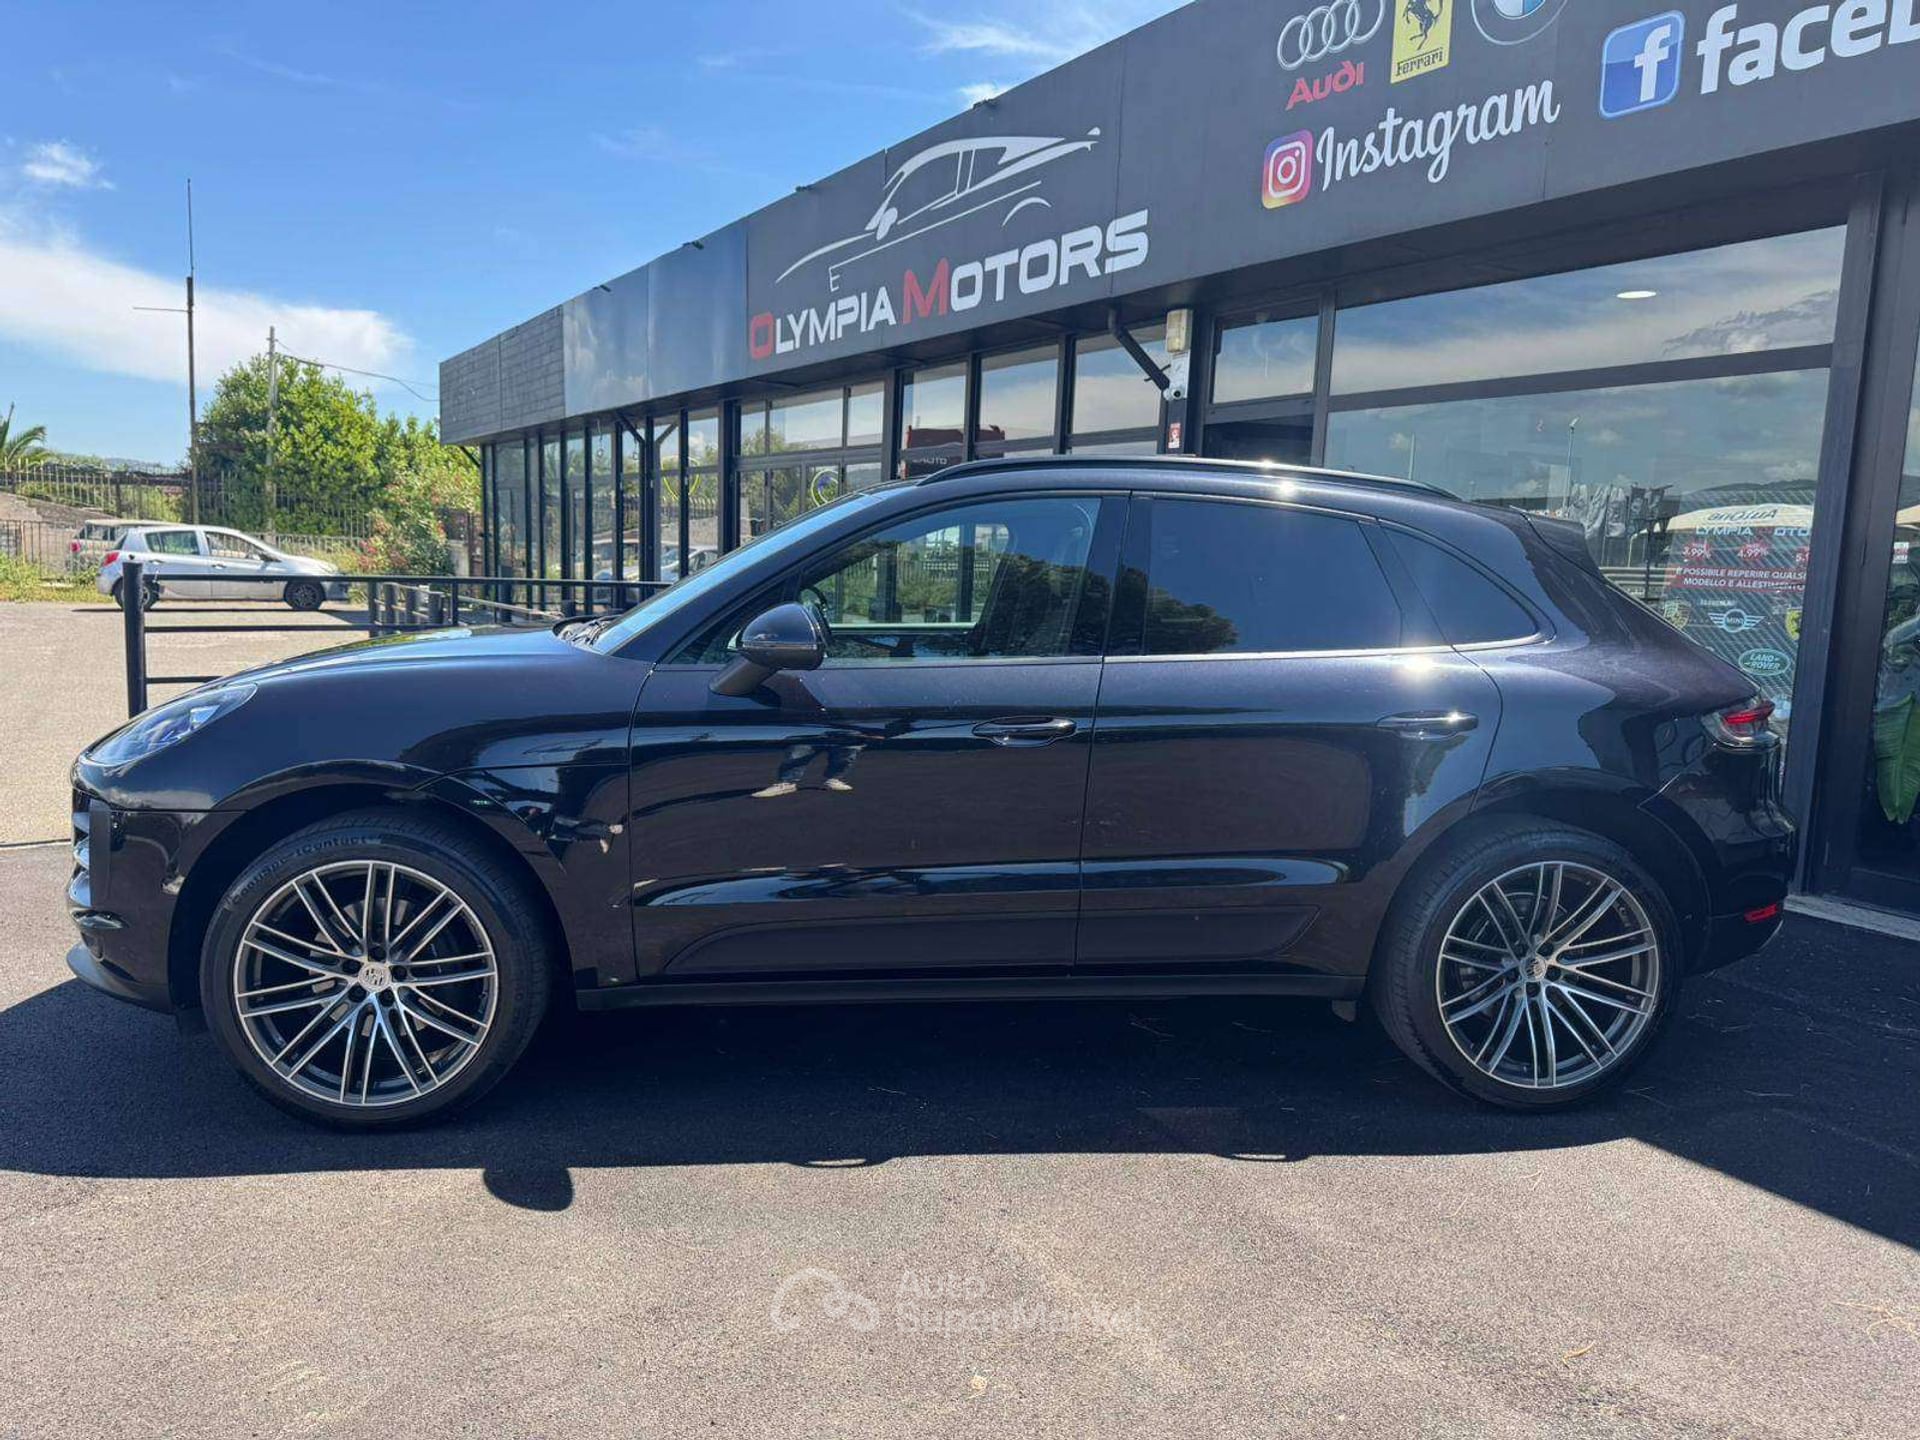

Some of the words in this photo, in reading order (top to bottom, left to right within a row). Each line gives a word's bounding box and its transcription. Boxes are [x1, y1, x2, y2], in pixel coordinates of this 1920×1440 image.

[1394, 47, 1444, 77] Ferrari
[1285, 60, 1364, 111] Audi
[1316, 79, 1561, 192] Instagram
[749, 285, 897, 361] OLYMPIA
[902, 208, 1150, 325] MOTORS
[1695, 524, 1754, 536] LYMPIA
[1683, 567, 1726, 578] POSSIBILE
[1727, 569, 1770, 579] REPERIRE
[1683, 577, 1727, 588] MODELLO
[1750, 661, 1781, 670] ROVER
